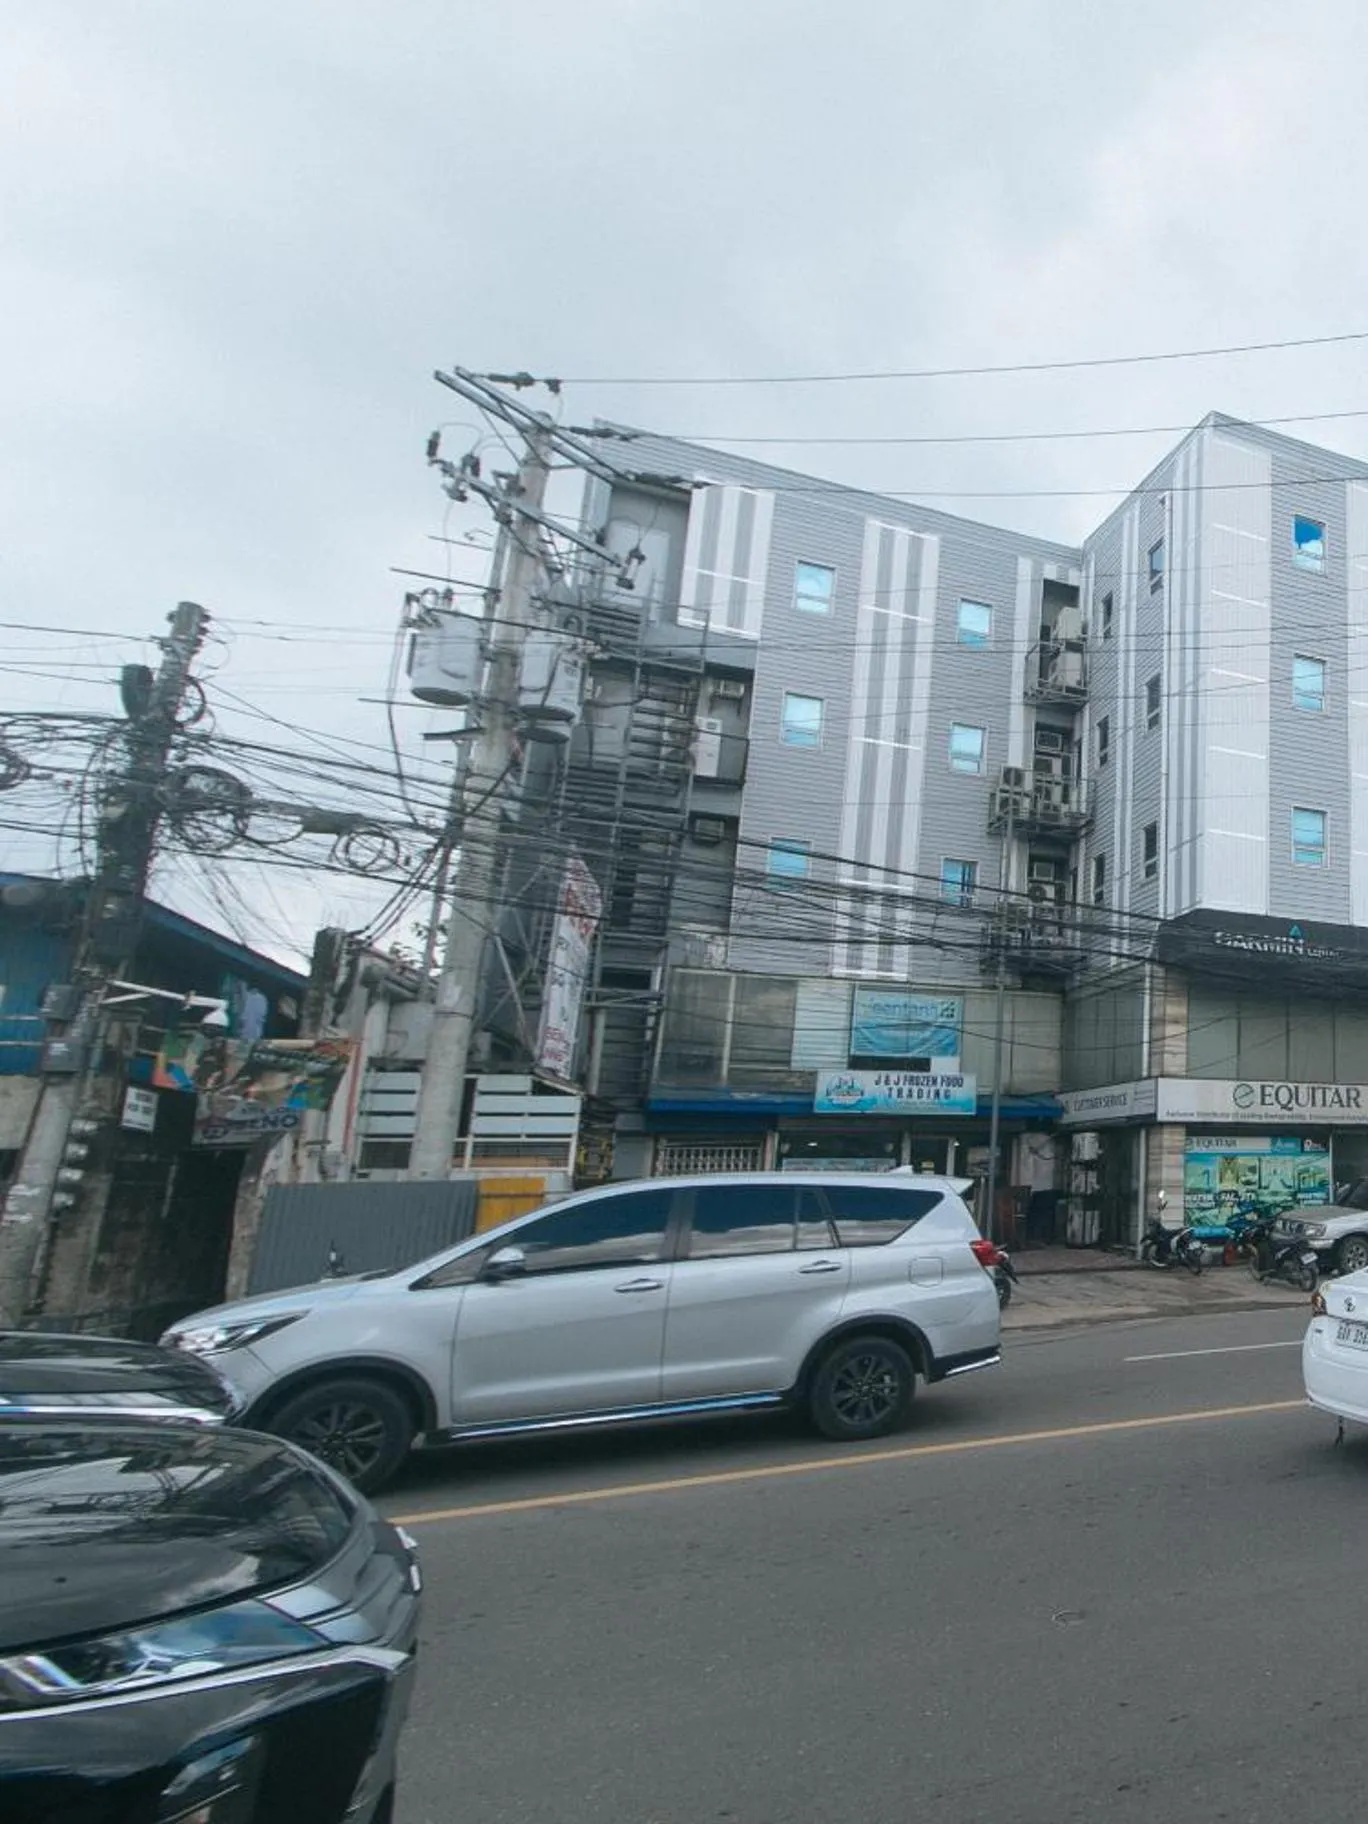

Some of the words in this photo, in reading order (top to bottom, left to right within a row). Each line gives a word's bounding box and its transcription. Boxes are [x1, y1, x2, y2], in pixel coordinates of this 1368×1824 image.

[902, 1074, 938, 1087] FROZEN
[940, 1074, 965, 1088] FOOD
[887, 1087, 951, 1099] TRADING
[1260, 1084, 1362, 1111] EQUITAR
